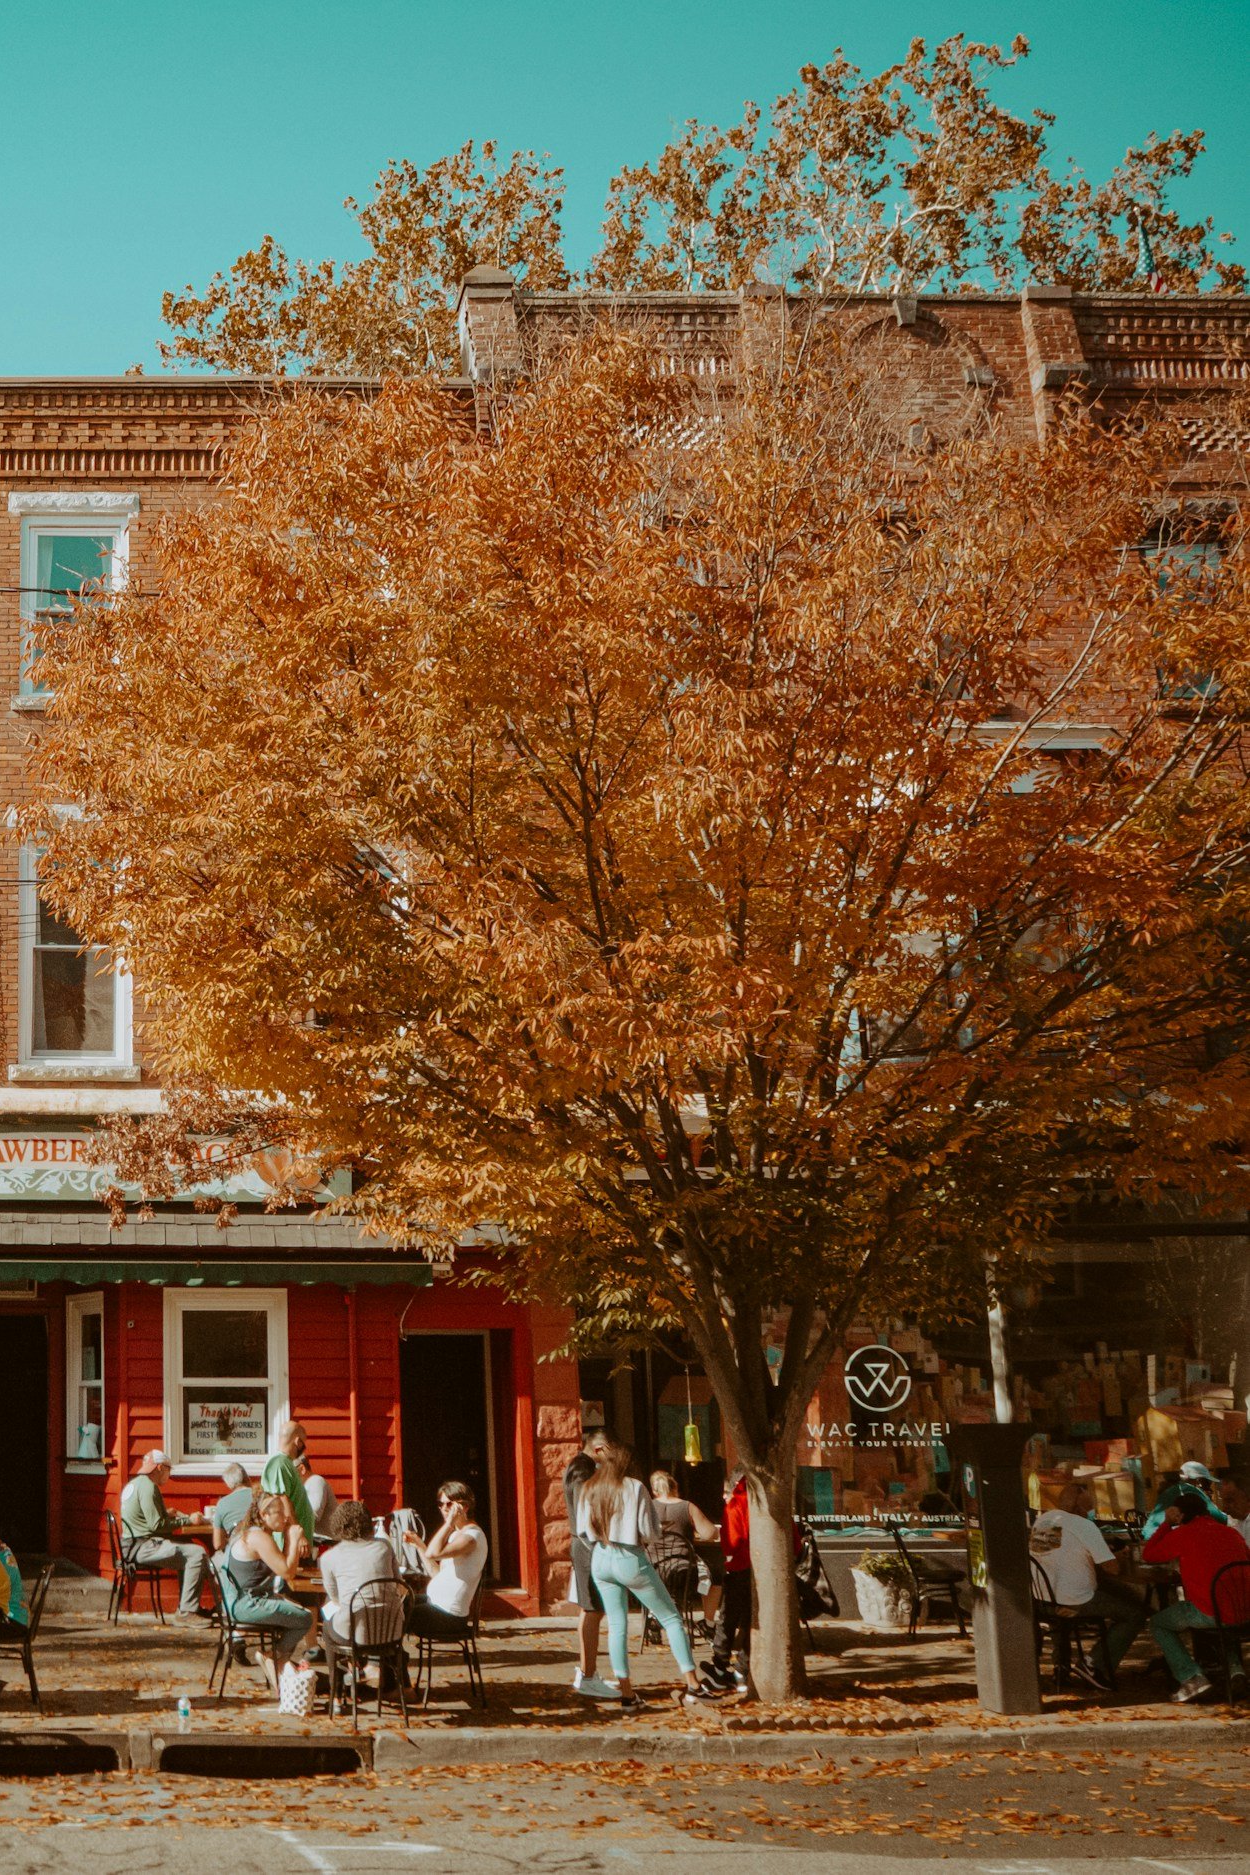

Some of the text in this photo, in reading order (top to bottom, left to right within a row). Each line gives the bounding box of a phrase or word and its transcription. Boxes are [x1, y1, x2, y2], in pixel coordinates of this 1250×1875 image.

[232, 1406, 253, 1418] You!
[196, 1431, 214, 1439] FIRST
[806, 1423, 857, 1437] WAC
[807, 1440, 853, 1448] ELEVATE
[859, 1440, 887, 1448] YOUR
[807, 1514, 871, 1523] SWITZERLAND
[878, 1513, 912, 1523] ITALY
[921, 1514, 961, 1523] AUSTRIA
